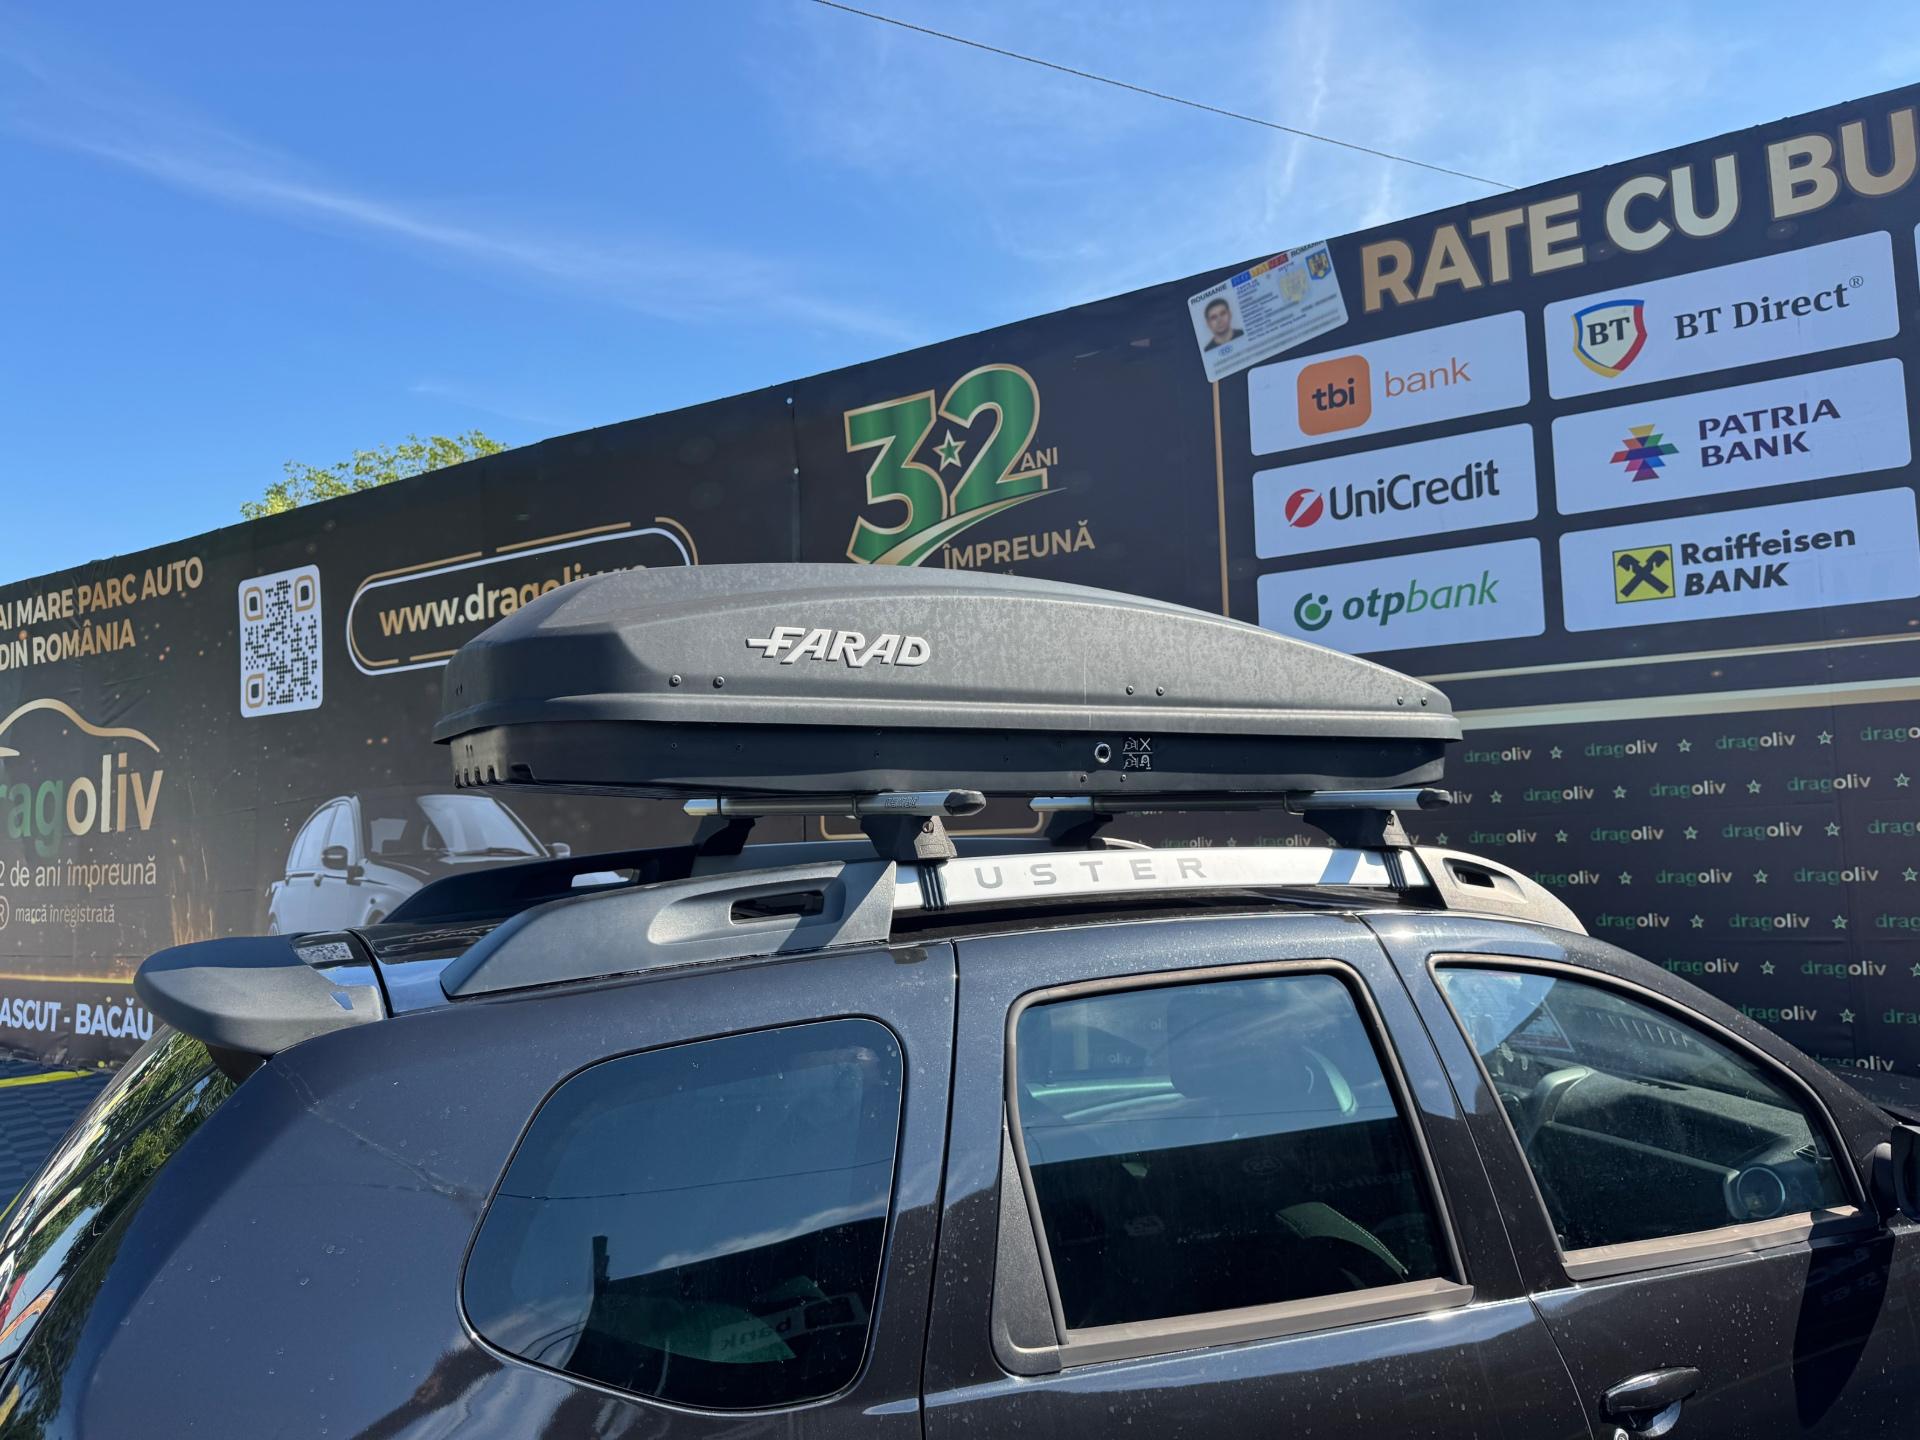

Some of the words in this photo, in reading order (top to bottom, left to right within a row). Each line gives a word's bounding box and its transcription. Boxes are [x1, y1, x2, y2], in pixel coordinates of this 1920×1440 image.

[1362, 194, 1585, 313] RATE
[1606, 153, 1739, 252] CU
[1767, 109, 1917, 220] BU
[1587, 316, 1631, 347] BT
[1674, 307, 1721, 340] BT
[1311, 377, 1355, 411] tbi
[1385, 357, 1472, 398] bank
[1698, 398, 1841, 440] PATRIA
[1020, 447, 1058, 472] ANI
[1700, 431, 1810, 468] BANK
[1329, 459, 1500, 520] UniCredit
[944, 519, 1096, 570] ÎMPREUNĂ
[1680, 528, 1856, 566] Raiffeisen
[17, 588, 74, 628] MARE
[78, 573, 137, 616] PARC
[141, 556, 204, 600] AUTO
[1684, 562, 1789, 597] BANK
[1342, 570, 1500, 626] otpbank
[0, 637, 28, 671] DIN
[32, 618, 137, 665] ROMÂNIA
[745, 626, 931, 668] FARAD
[1464, 747, 1532, 764] dragoliv
[1585, 740, 1658, 758] dragoliv
[1715, 732, 1796, 751] dragoliv
[1523, 786, 1595, 804] dragoliv
[1649, 780, 1727, 798] dragoliv
[1787, 774, 1872, 793] dragoliv
[1469, 829, 1537, 846] dragoliv
[1590, 826, 1664, 843] dragoliv
[1721, 822, 1803, 841] dragoliv
[10, 859, 30, 887] de
[35, 859, 61, 887] ani
[67, 855, 157, 890] împreună
[1655, 869, 1733, 887] dragoliv
[1794, 867, 1879, 886] dragoliv
[15, 904, 47, 923] marcă
[49, 904, 115, 927] înregistrată
[1596, 913, 1670, 930] dragoliv
[1729, 912, 1810, 930] dragoliv
[1801, 960, 1887, 979] dragoliv
[75, 997, 154, 1041] BACĂU
